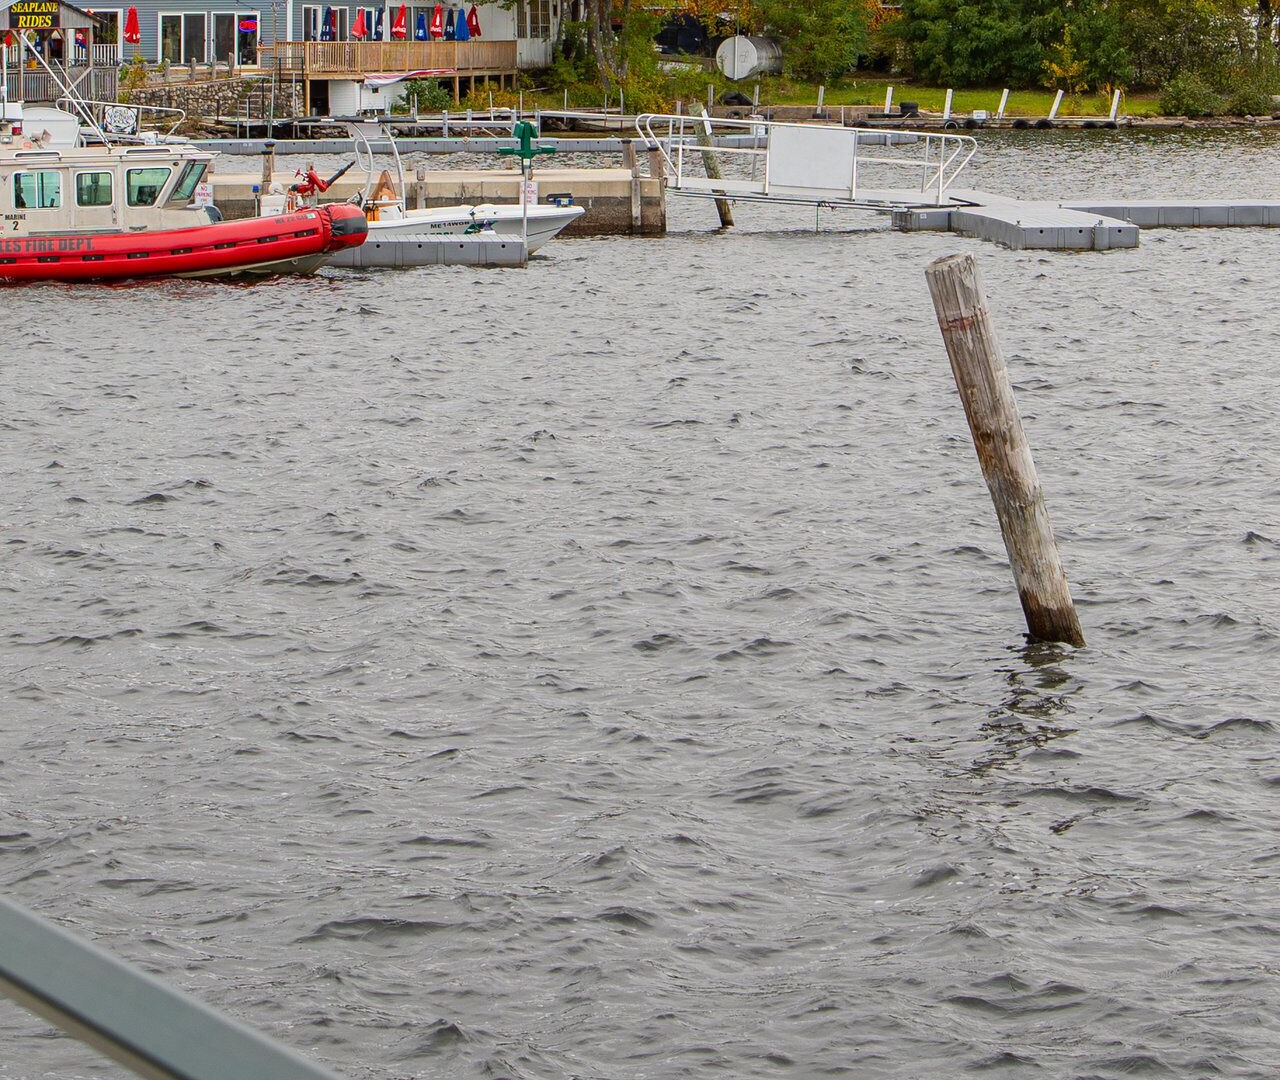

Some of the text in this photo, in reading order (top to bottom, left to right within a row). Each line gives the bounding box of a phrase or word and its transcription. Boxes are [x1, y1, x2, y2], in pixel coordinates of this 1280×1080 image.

[11, 2, 58, 13] SEAPLANE
[18, 15, 52, 28] RIDES
[13, 221, 19, 231] 2
[25, 238, 54, 252] FIRE
[59, 237, 95, 251] DEPT.
